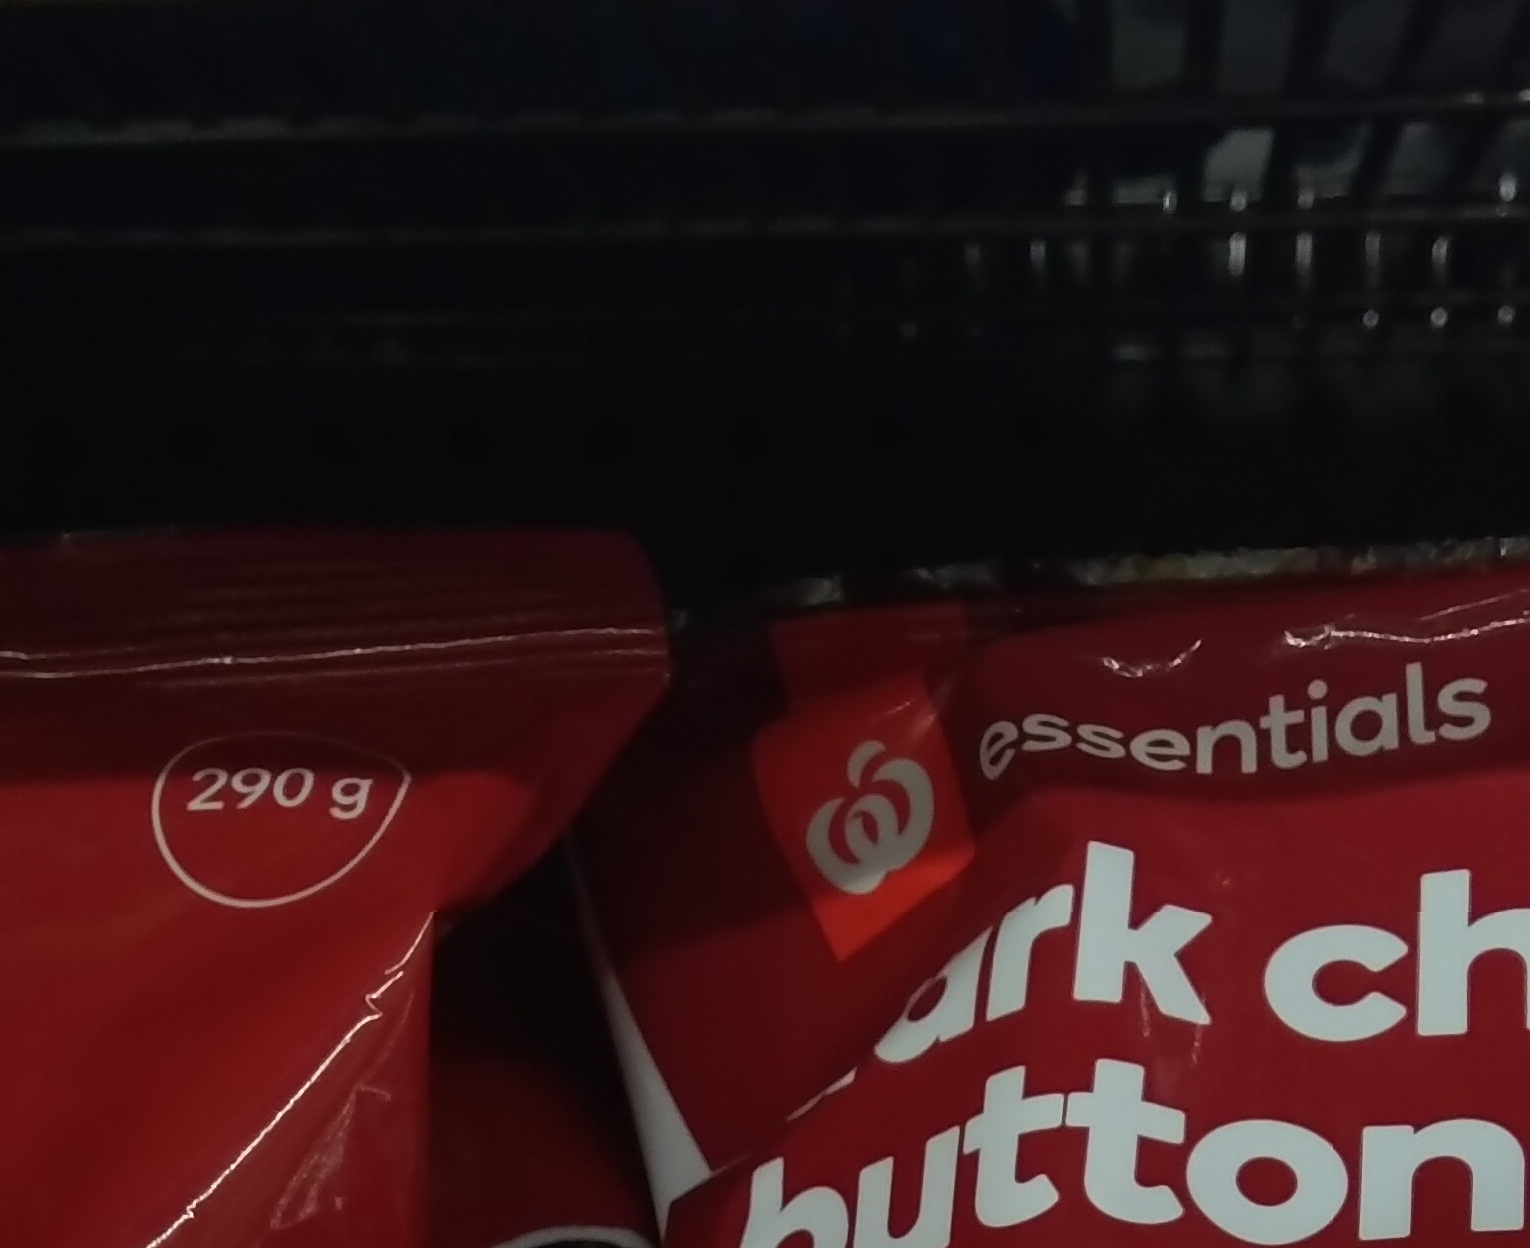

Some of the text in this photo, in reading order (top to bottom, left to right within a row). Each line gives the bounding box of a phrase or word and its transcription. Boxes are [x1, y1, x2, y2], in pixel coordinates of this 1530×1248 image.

[978, 664, 1492, 780] essentials
[185, 766, 373, 820] 290 g
[786, 840, 1211, 1115] ark
